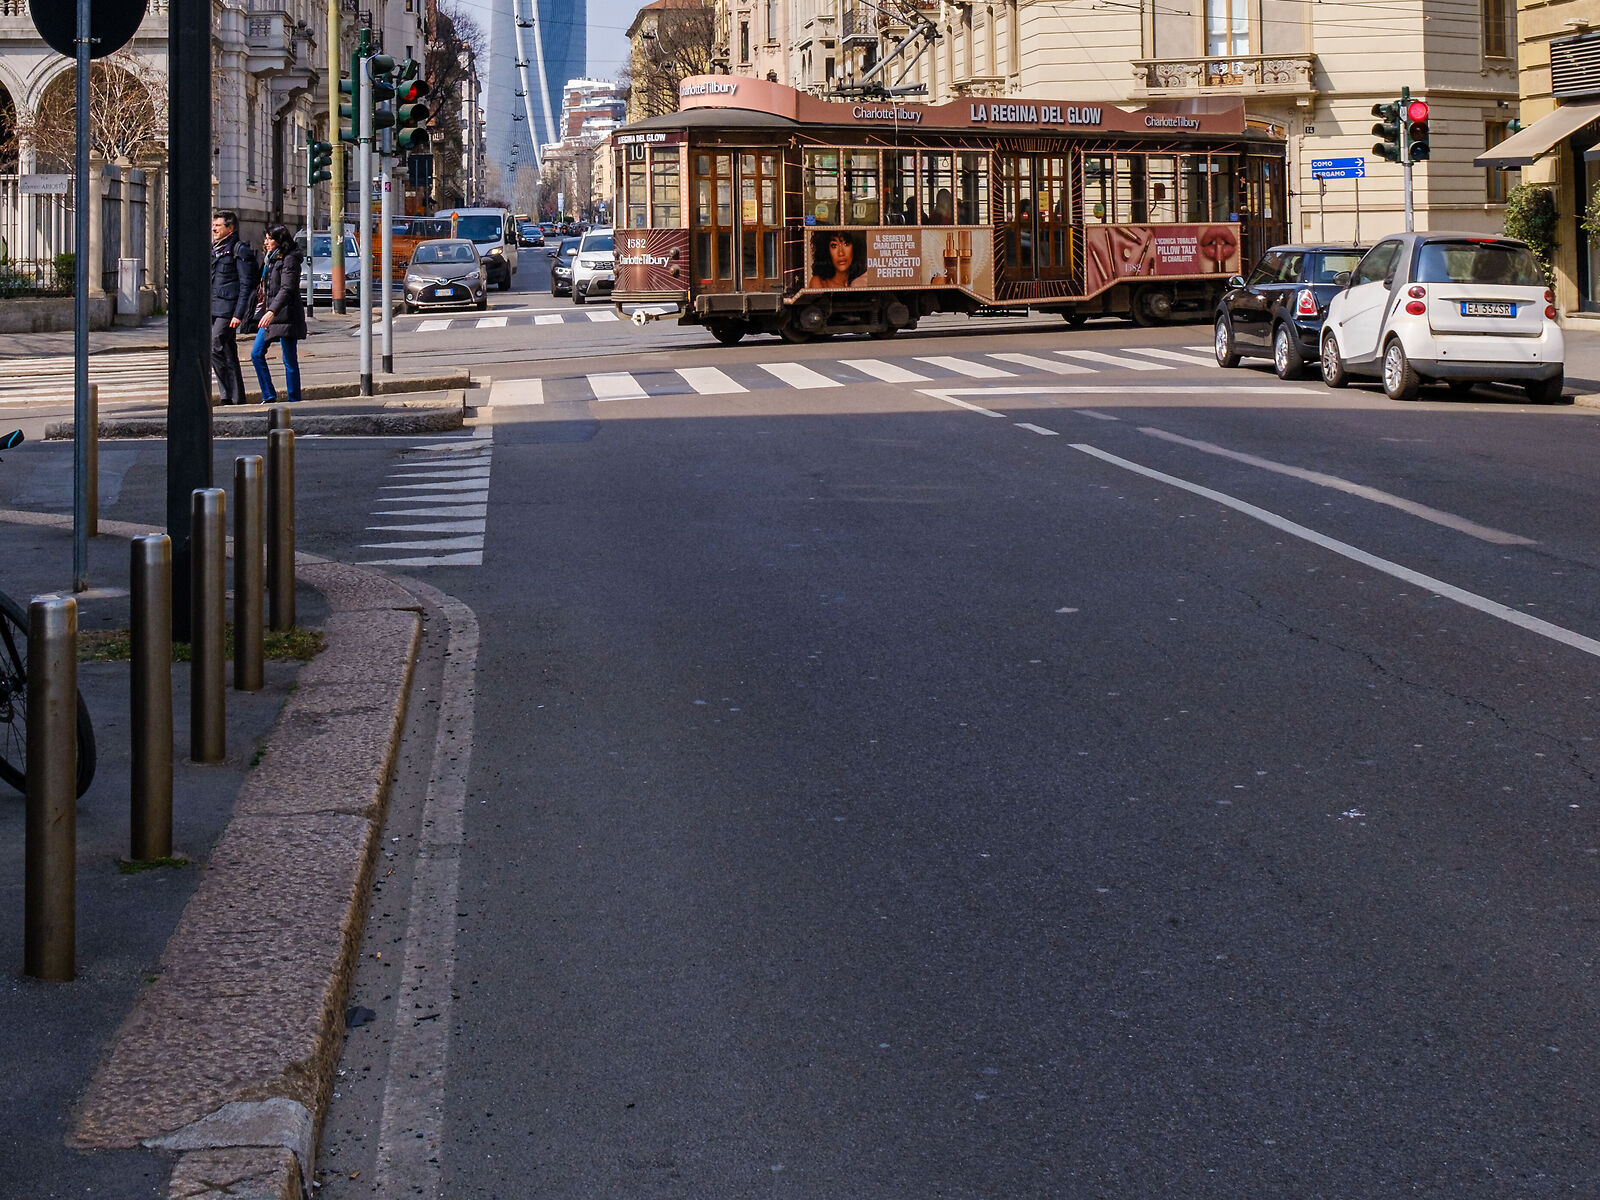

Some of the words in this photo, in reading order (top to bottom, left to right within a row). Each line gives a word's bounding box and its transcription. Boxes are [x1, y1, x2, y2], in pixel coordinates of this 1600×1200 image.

[970, 103, 987, 121] LA
[991, 104, 1038, 122] REGINA
[1041, 106, 1064, 123] DEL
[1067, 107, 1101, 124] GLOW
[636, 134, 646, 142] DEL
[646, 133, 666, 142] GLOW
[631, 144, 644, 160] 10
[627, 238, 646, 249] 1582
[875, 234, 881, 243] IL
[882, 234, 905, 242] SEGRETO
[906, 234, 912, 242] DI
[873, 242, 903, 250] CHARLOTTE
[1157, 245, 1180, 255] PILLOW
[1181, 245, 1197, 254] TALK
[867, 257, 920, 267] DALL'ASPETTO
[877, 267, 914, 278] PERFETTO
